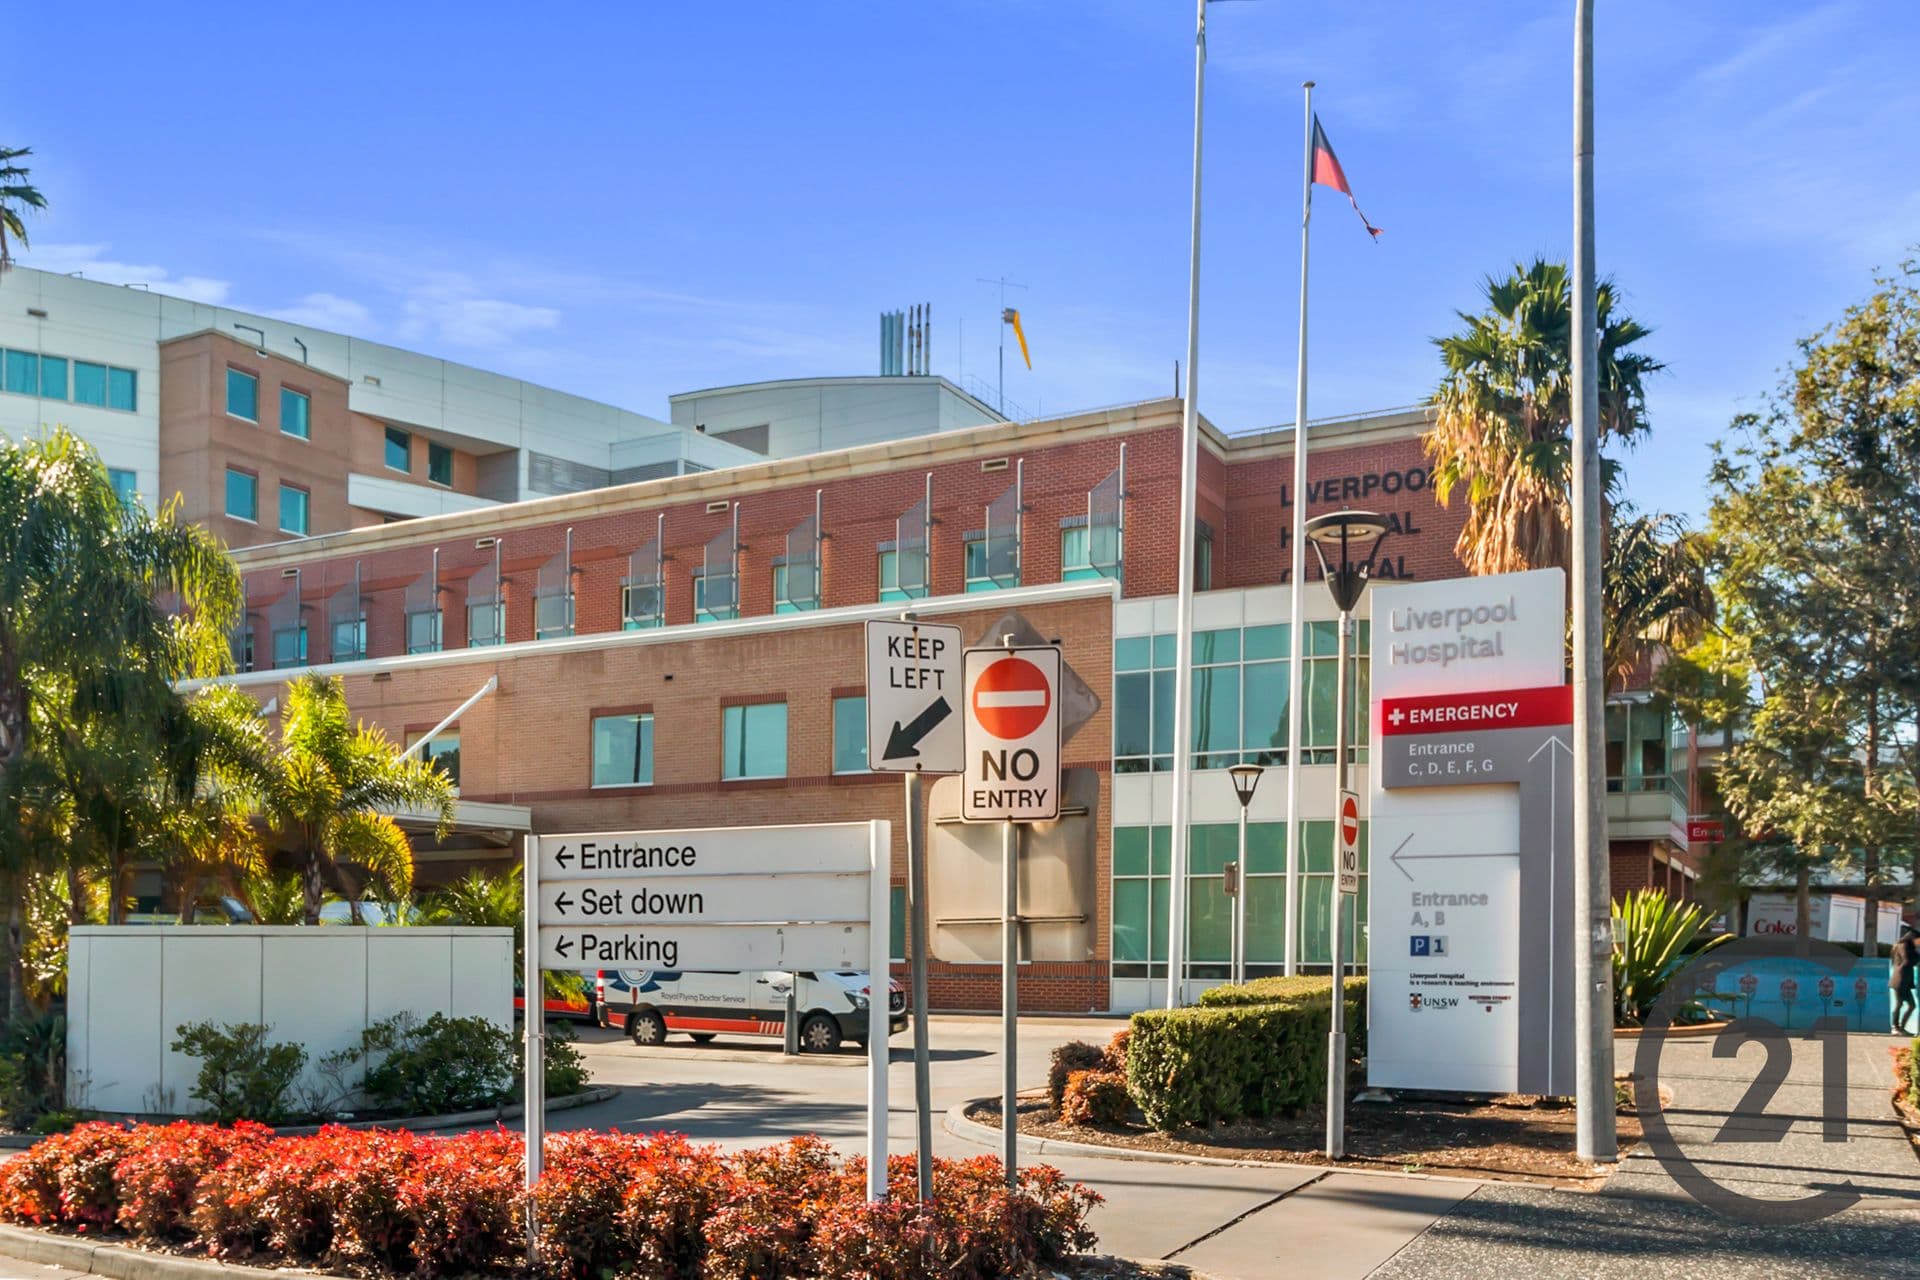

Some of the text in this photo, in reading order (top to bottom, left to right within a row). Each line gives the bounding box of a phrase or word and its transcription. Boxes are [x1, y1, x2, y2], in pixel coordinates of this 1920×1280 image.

[1280, 466, 1435, 507] LVERPOO
[1391, 595, 1517, 632] Liverpool
[888, 636, 945, 660] KEEP
[1391, 631, 1504, 668] Hospital
[890, 666, 945, 690] LEFT
[1409, 702, 1519, 724] EMERGENCY
[1409, 742, 1475, 756] Entrance
[982, 748, 1040, 782] NO
[1482, 759, 1493, 772] G
[973, 789, 1048, 808] ENTRY
[580, 843, 697, 869] Entrance
[1343, 851, 1355, 871] NO
[1341, 874, 1356, 886] ENTRY
[580, 887, 703, 915] Set down
[1411, 891, 1489, 906] Entrance
[1434, 911, 1445, 926] B
[1754, 917, 1796, 934] Coke
[580, 934, 678, 967] Parking
[1423, 998, 1459, 1007] UNSW
